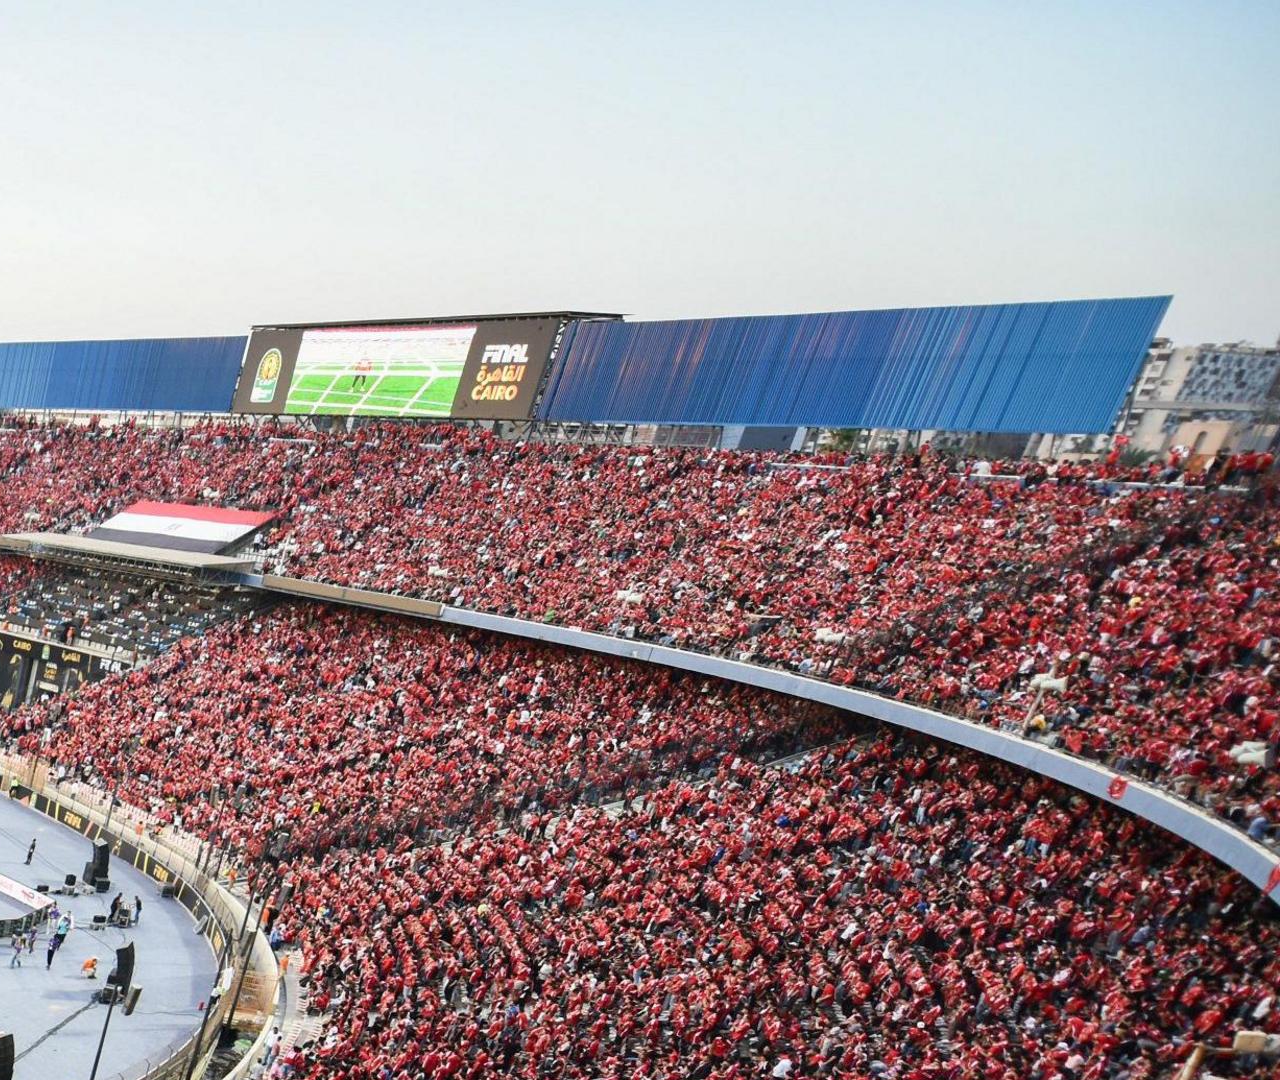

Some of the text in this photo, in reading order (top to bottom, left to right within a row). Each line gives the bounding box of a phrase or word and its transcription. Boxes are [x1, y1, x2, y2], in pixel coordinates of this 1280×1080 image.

[481, 343, 529, 363] FINAL
[476, 364, 527, 386] القاهرة
[471, 384, 518, 401] CAIRO
